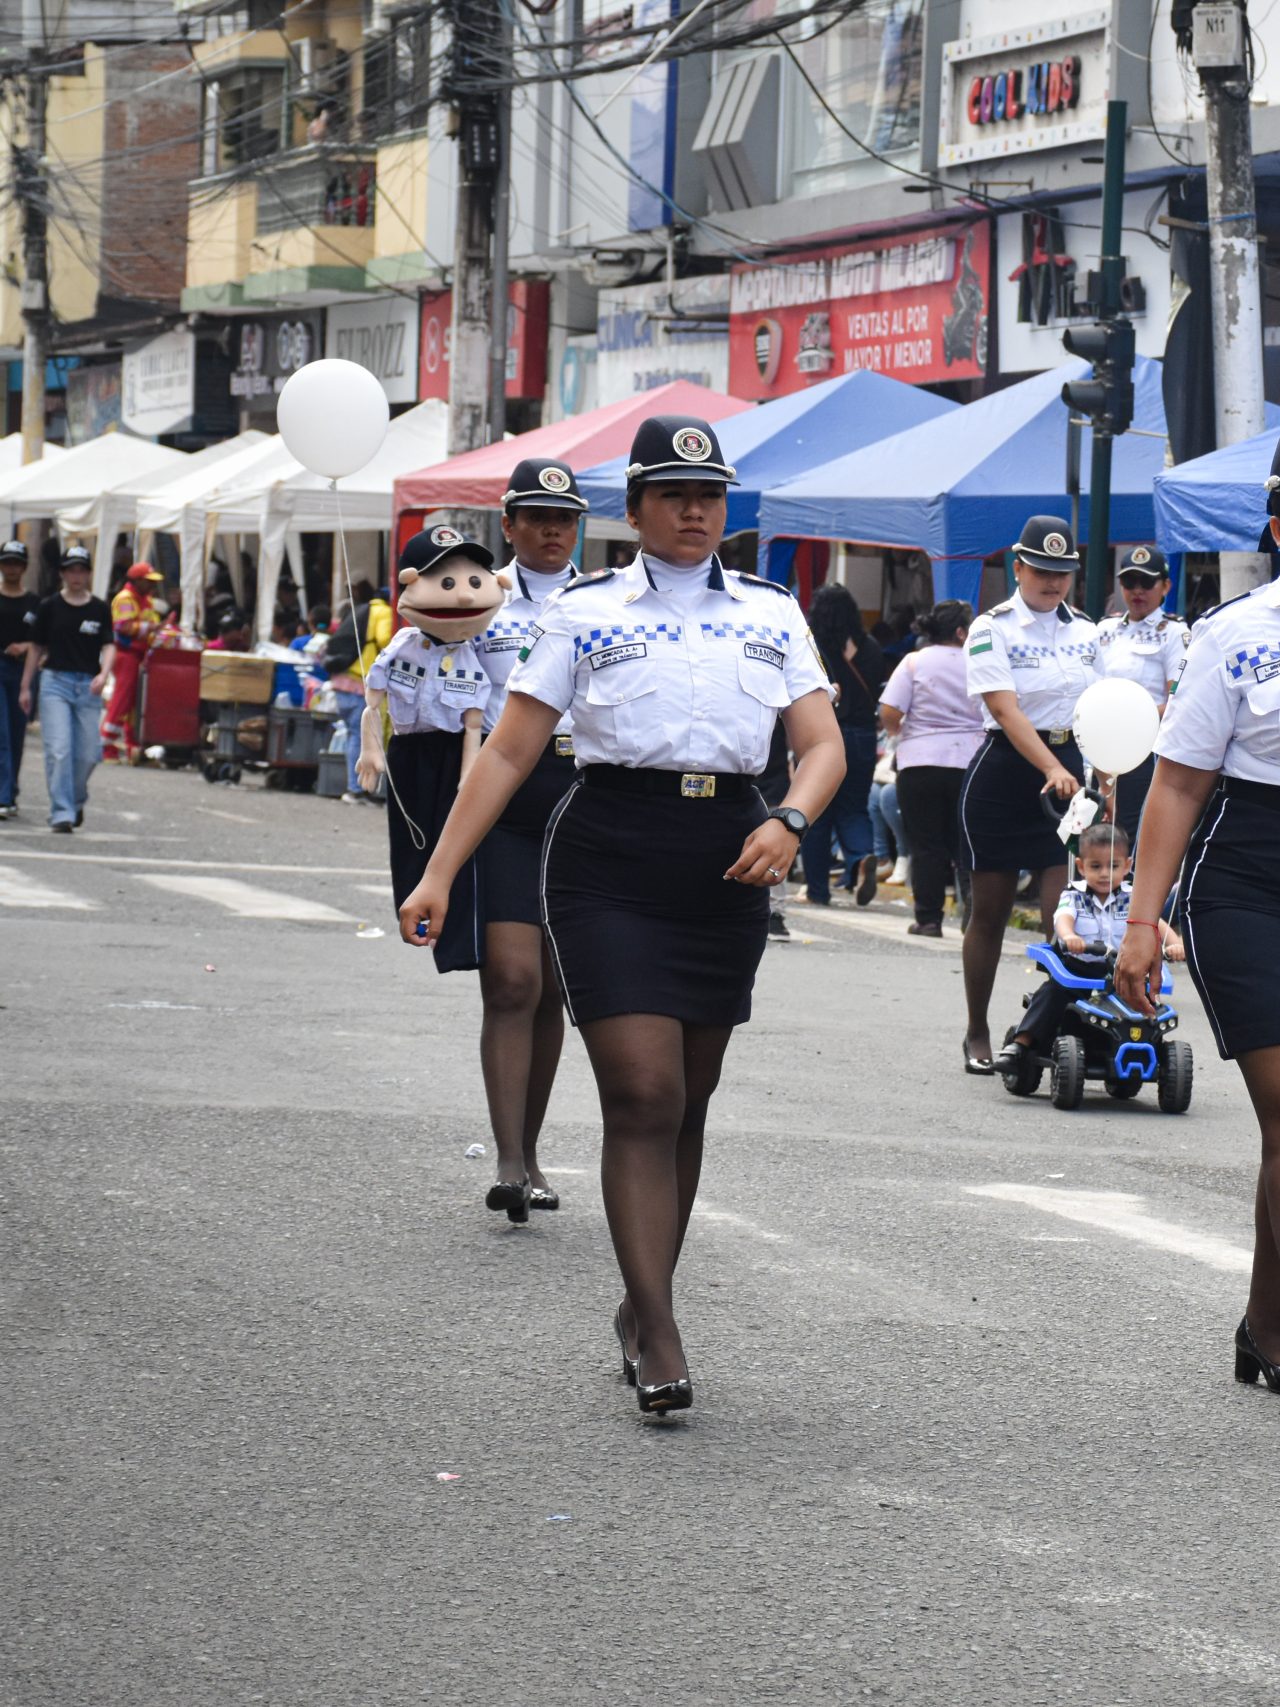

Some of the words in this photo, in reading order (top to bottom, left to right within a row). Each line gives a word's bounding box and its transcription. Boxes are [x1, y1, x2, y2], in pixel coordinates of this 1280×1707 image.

[1206, 17, 1225, 33] N11
[968, 68, 1020, 125] COOL
[1025, 55, 1077, 114] KIDS
[880, 236, 948, 293] MILAGRO
[848, 310, 889, 340] VENTAS
[891, 307, 904, 334] AL
[907, 304, 928, 332] POR
[844, 344, 881, 373] MAYOR
[884, 343, 892, 369] Y
[894, 338, 932, 368] MENOR
[747, 645, 781, 666] TRANSITO
